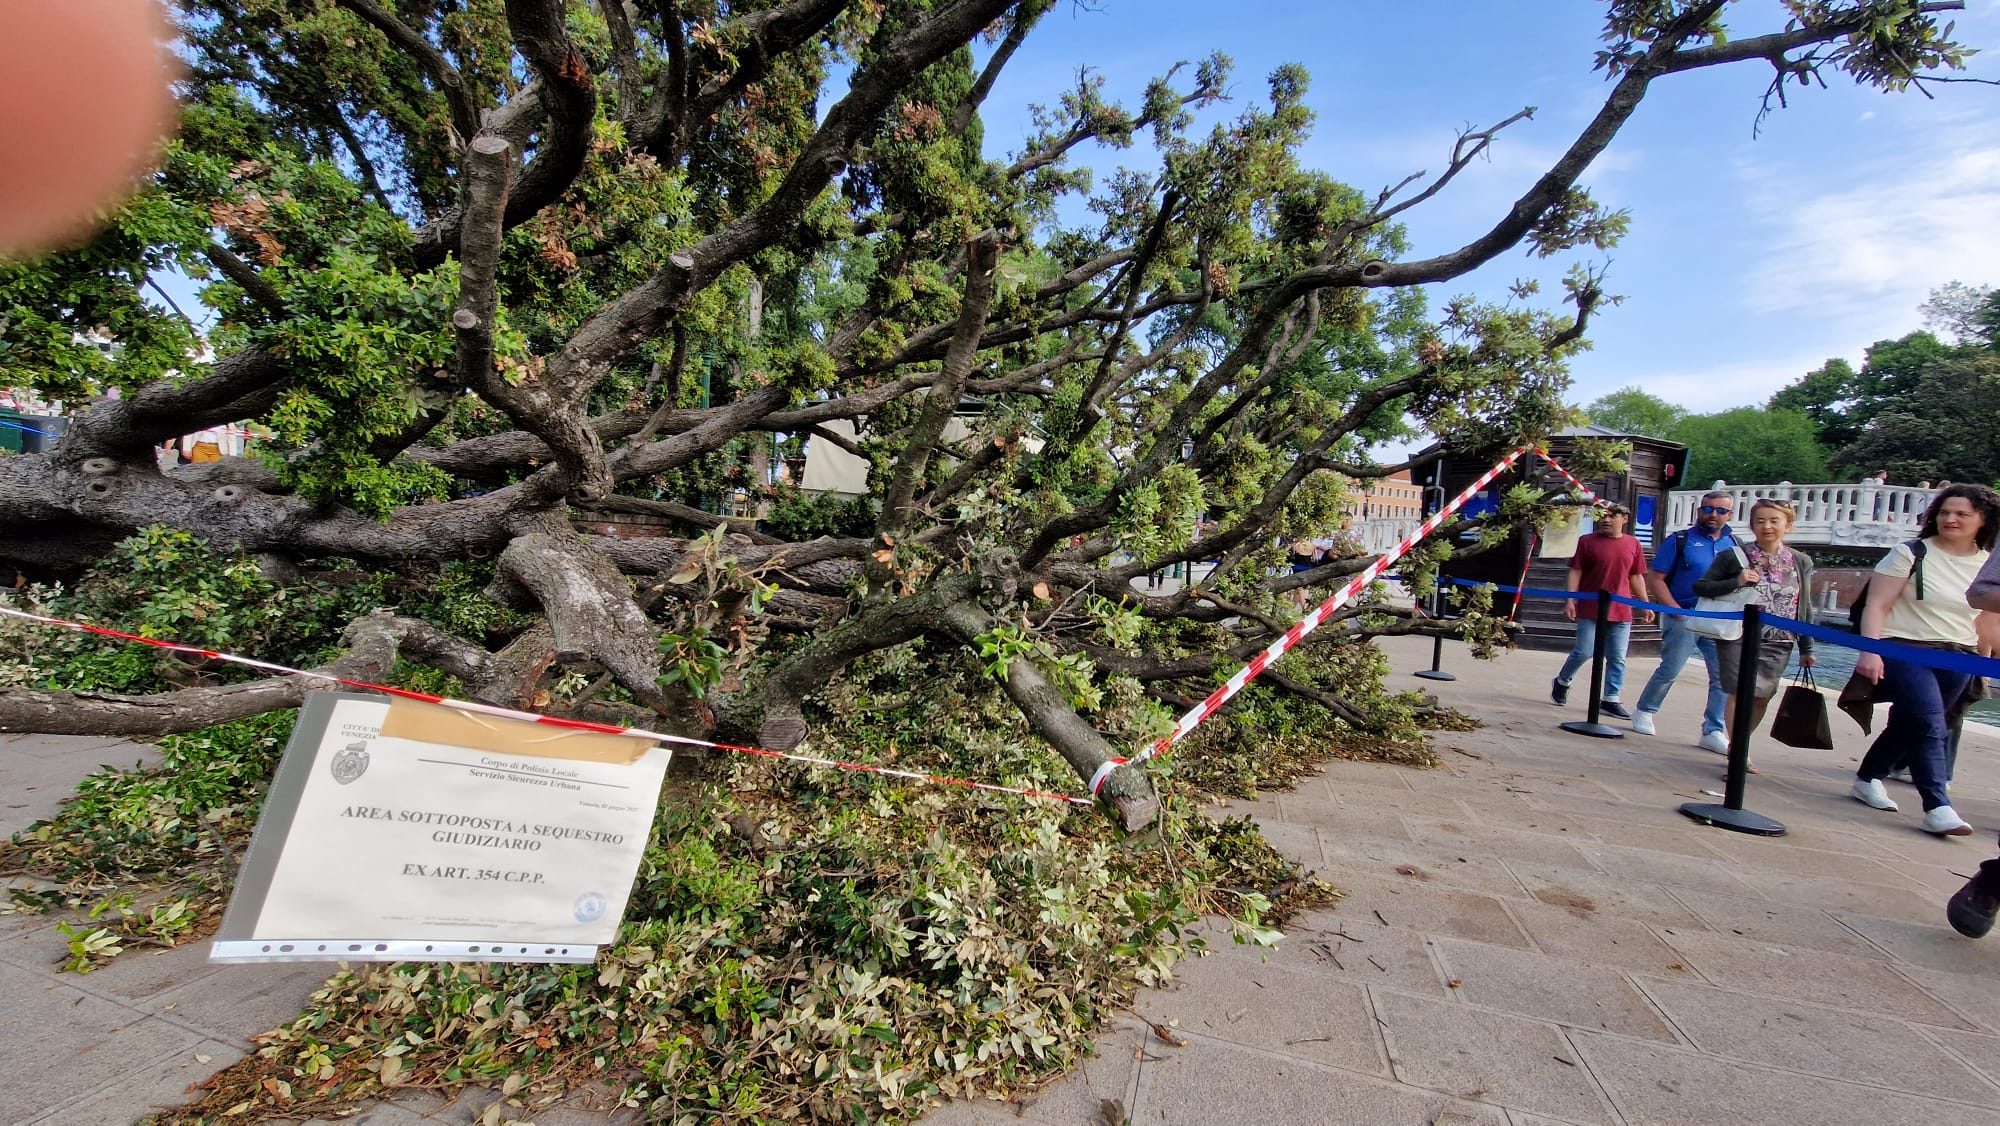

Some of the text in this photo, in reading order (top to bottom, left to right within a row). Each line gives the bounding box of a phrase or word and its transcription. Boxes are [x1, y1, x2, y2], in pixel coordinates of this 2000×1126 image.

[341, 730, 376, 739] VENEZIA
[481, 757, 579, 778] Corpo di Polizia Locale
[469, 768, 581, 791] Servizio Sicurezza Urbana
[340, 805, 624, 845] AREA SOTTOPOSTA A SEQUESTRO
[432, 830, 541, 852] GIUDIZIARIO
[400, 863, 545, 884] EX ART. 354 C.P.P.
